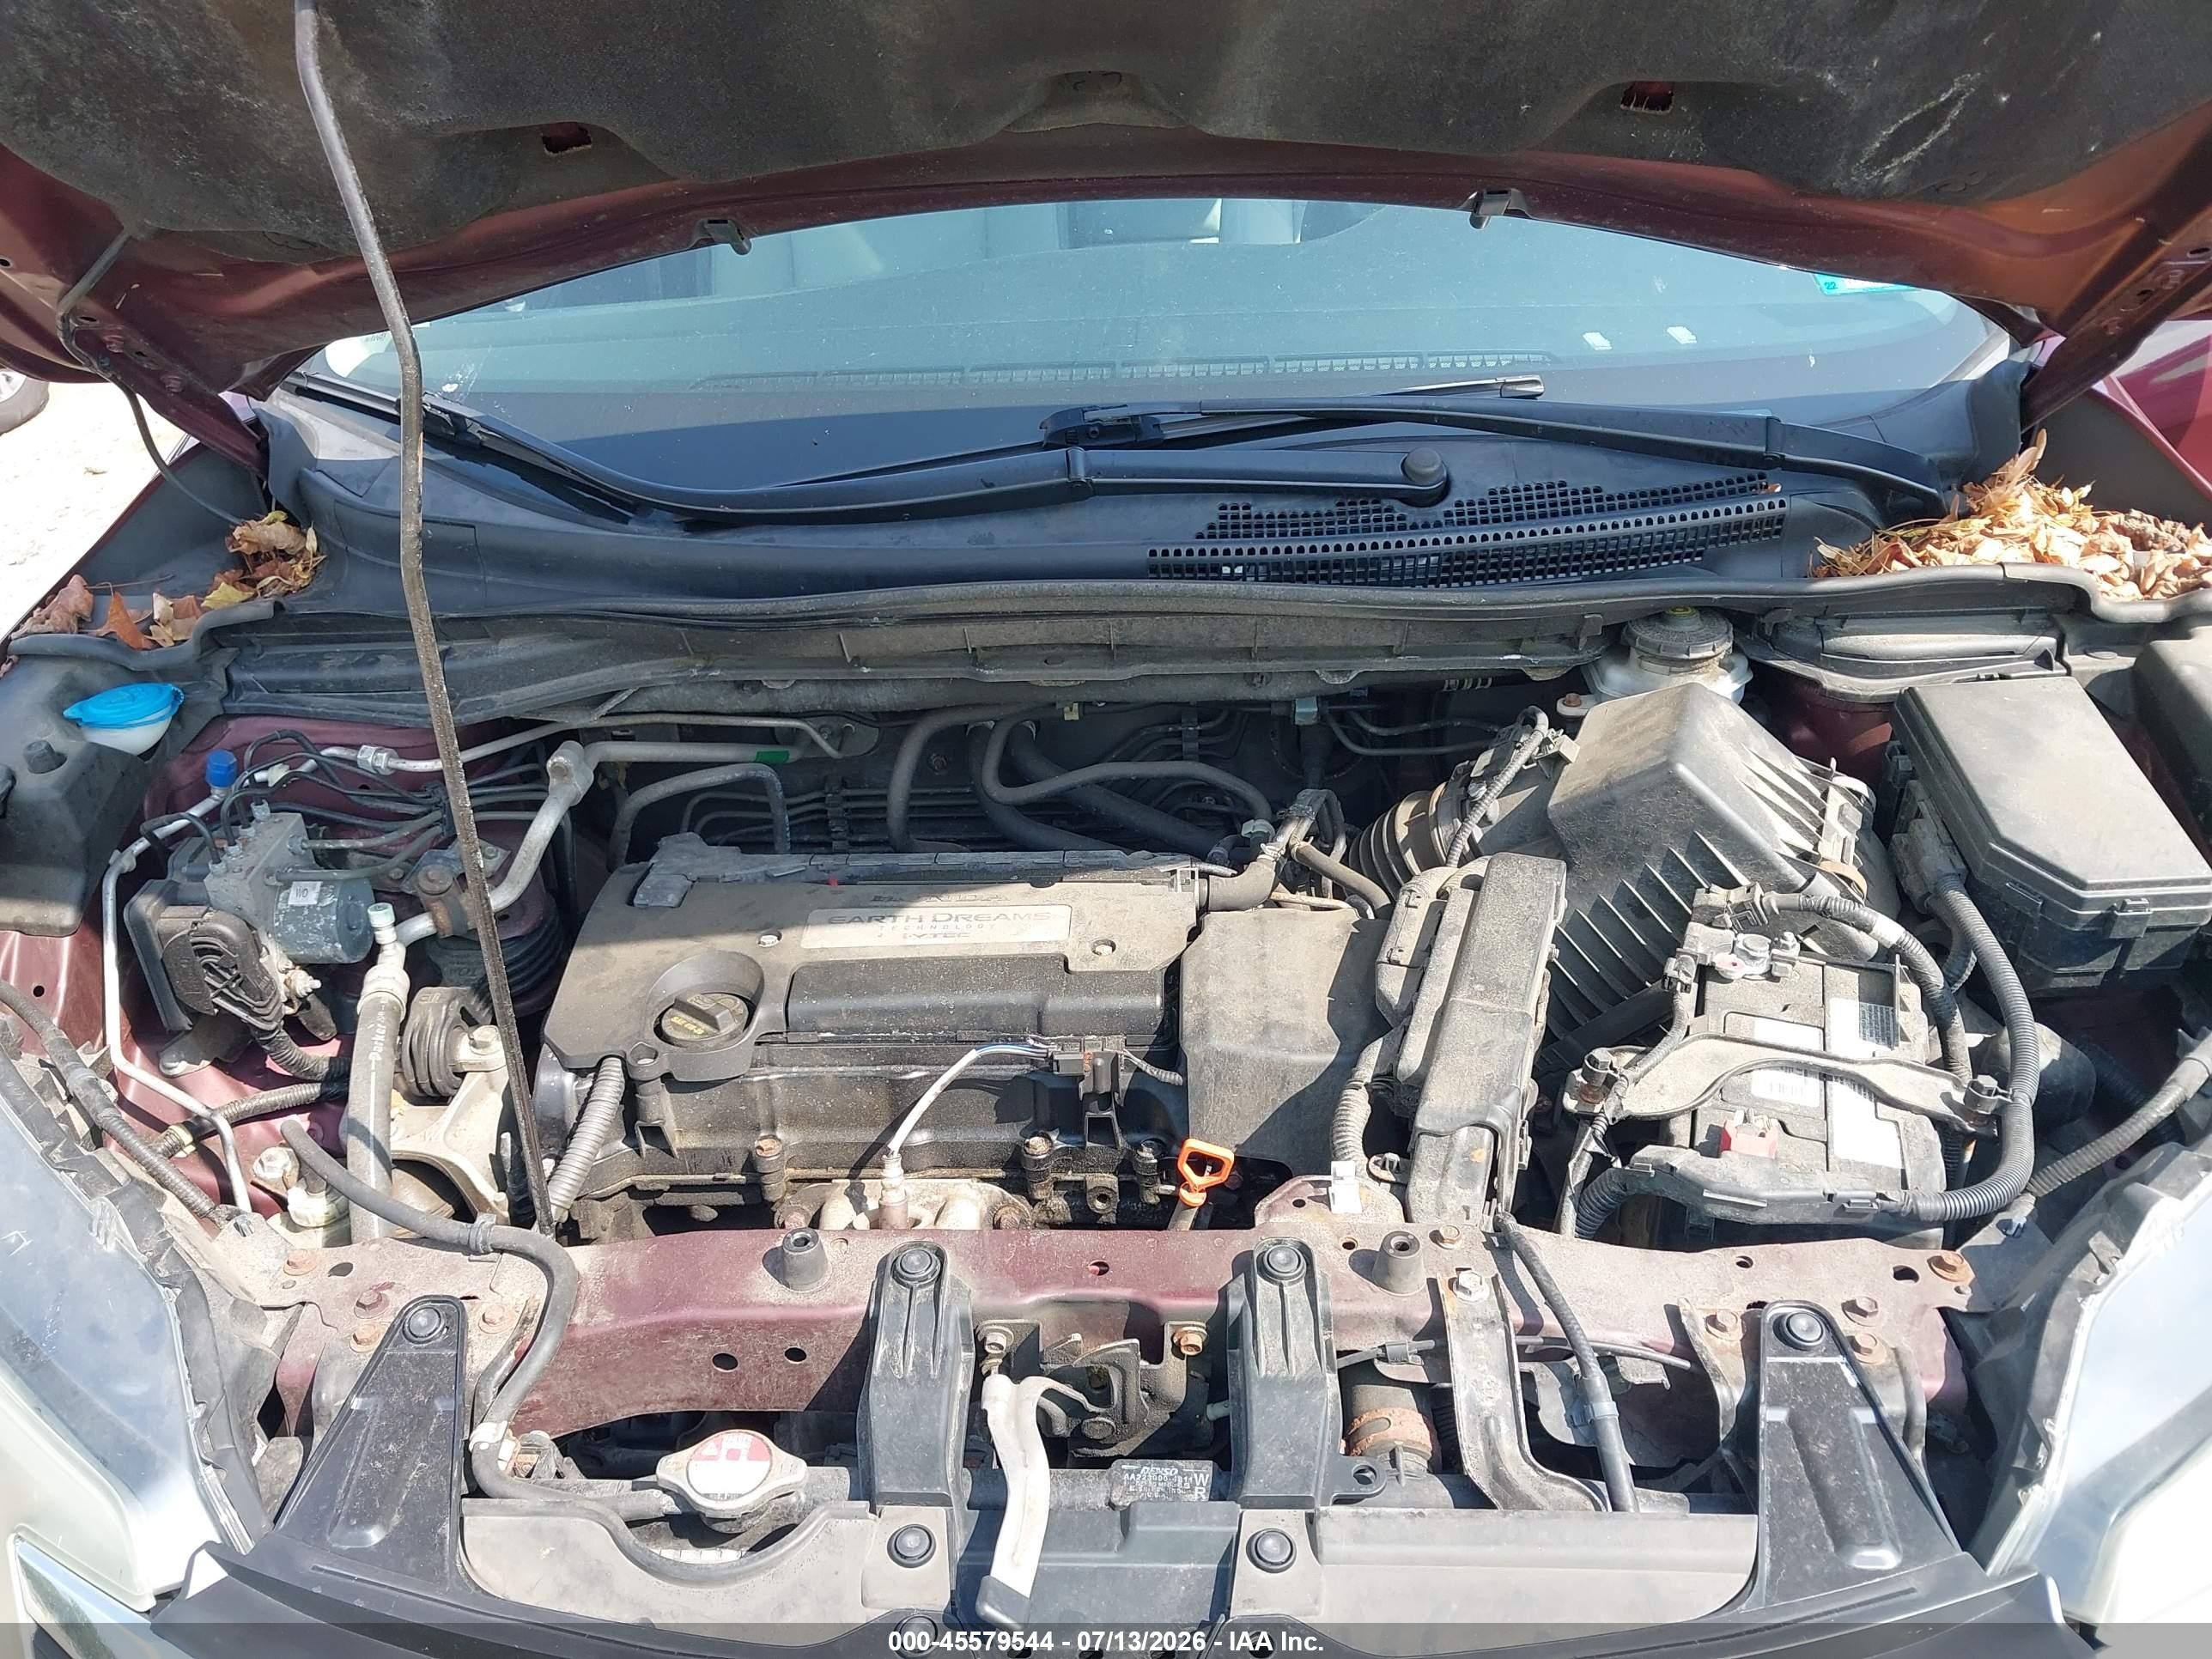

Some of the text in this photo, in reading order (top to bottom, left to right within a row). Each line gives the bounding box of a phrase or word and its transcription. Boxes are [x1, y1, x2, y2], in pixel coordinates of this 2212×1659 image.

[829, 912, 1051, 925] EARTH DREAMS
[368, 1023, 386, 1061] Parker
[1140, 1467, 1179, 1475] DENSO
